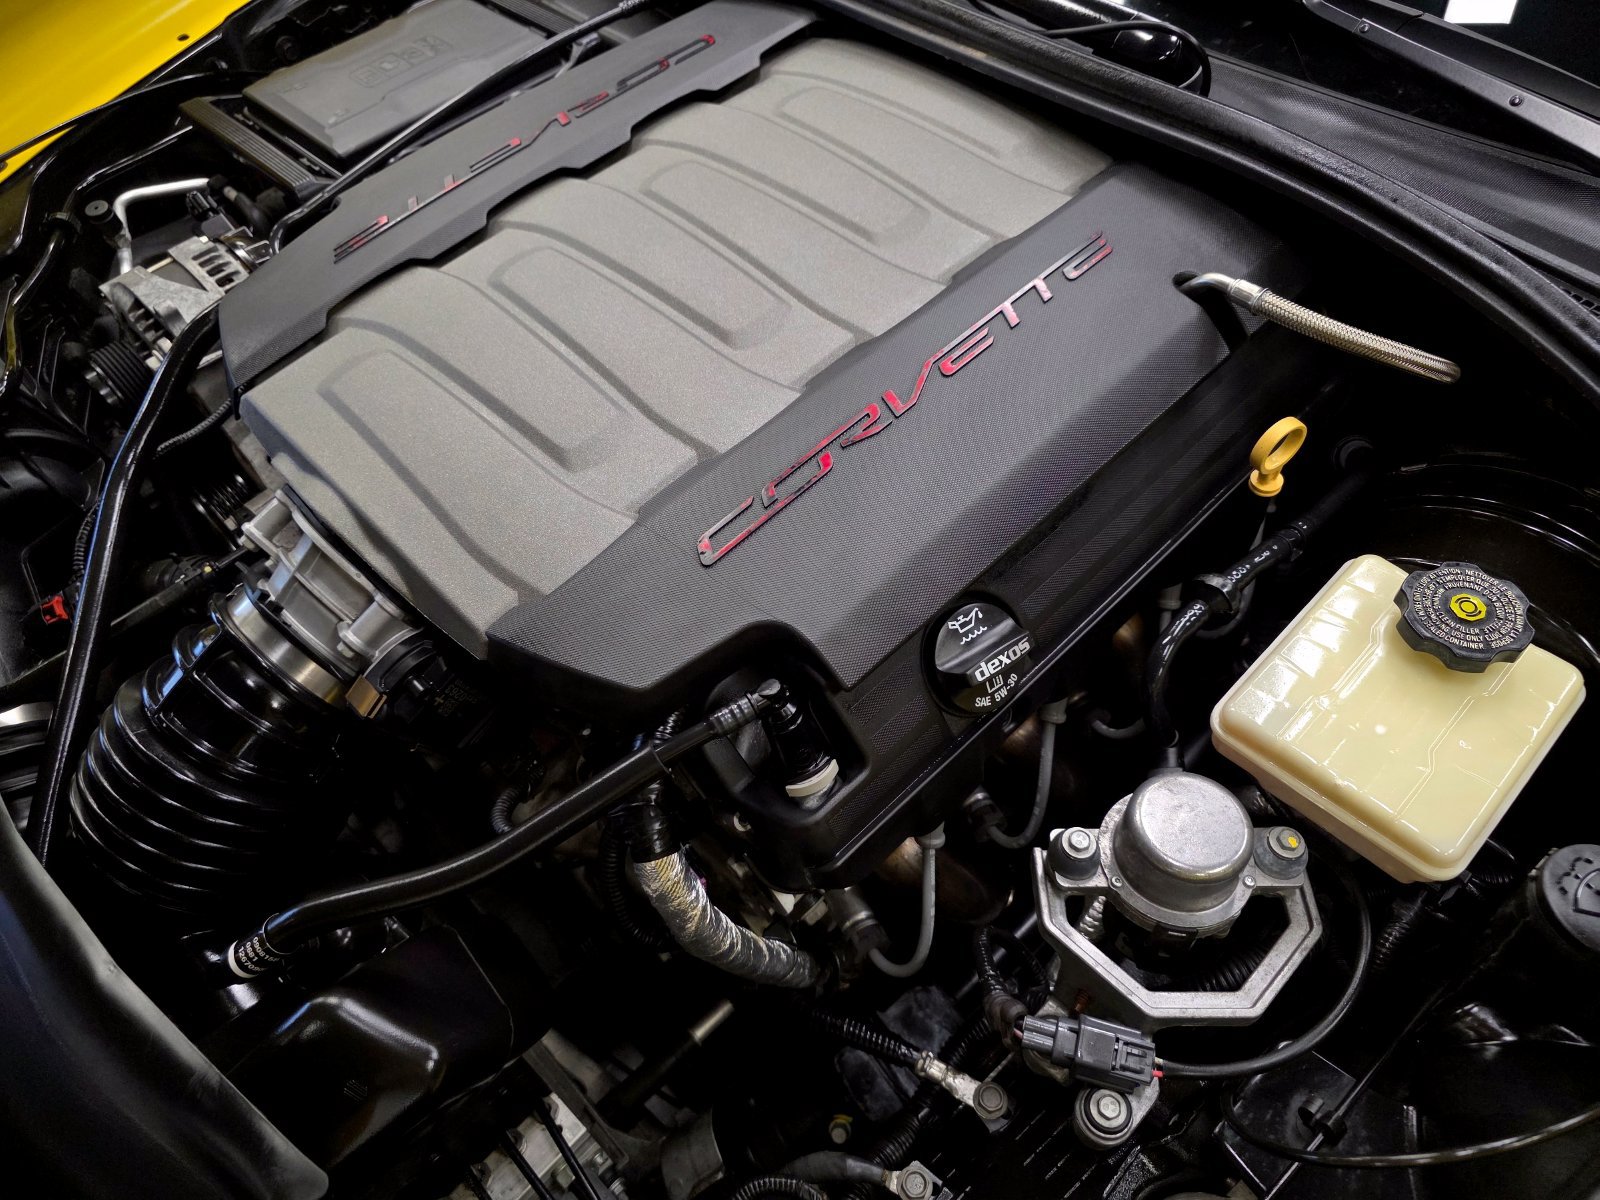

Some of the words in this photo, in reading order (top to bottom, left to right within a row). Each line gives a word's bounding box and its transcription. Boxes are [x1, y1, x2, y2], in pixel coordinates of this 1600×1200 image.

[333, 34, 716, 265] CORVETTE
[697, 232, 1113, 566] CORVETTE
[1465, 569, 1499, 585] NETTOYER
[1498, 584, 1508, 592] LE
[1475, 579, 1491, 590] QUE
[1424, 620, 1446, 638] SEALED
[1436, 611, 1455, 628] CLEAN
[1456, 624, 1480, 634] FILLER
[1451, 630, 1465, 640] USE
[1466, 632, 1483, 642] ONLY
[974, 636, 1031, 682] dexos
[974, 696, 992, 707] SAE
[994, 673, 1018, 702] 5W-30
